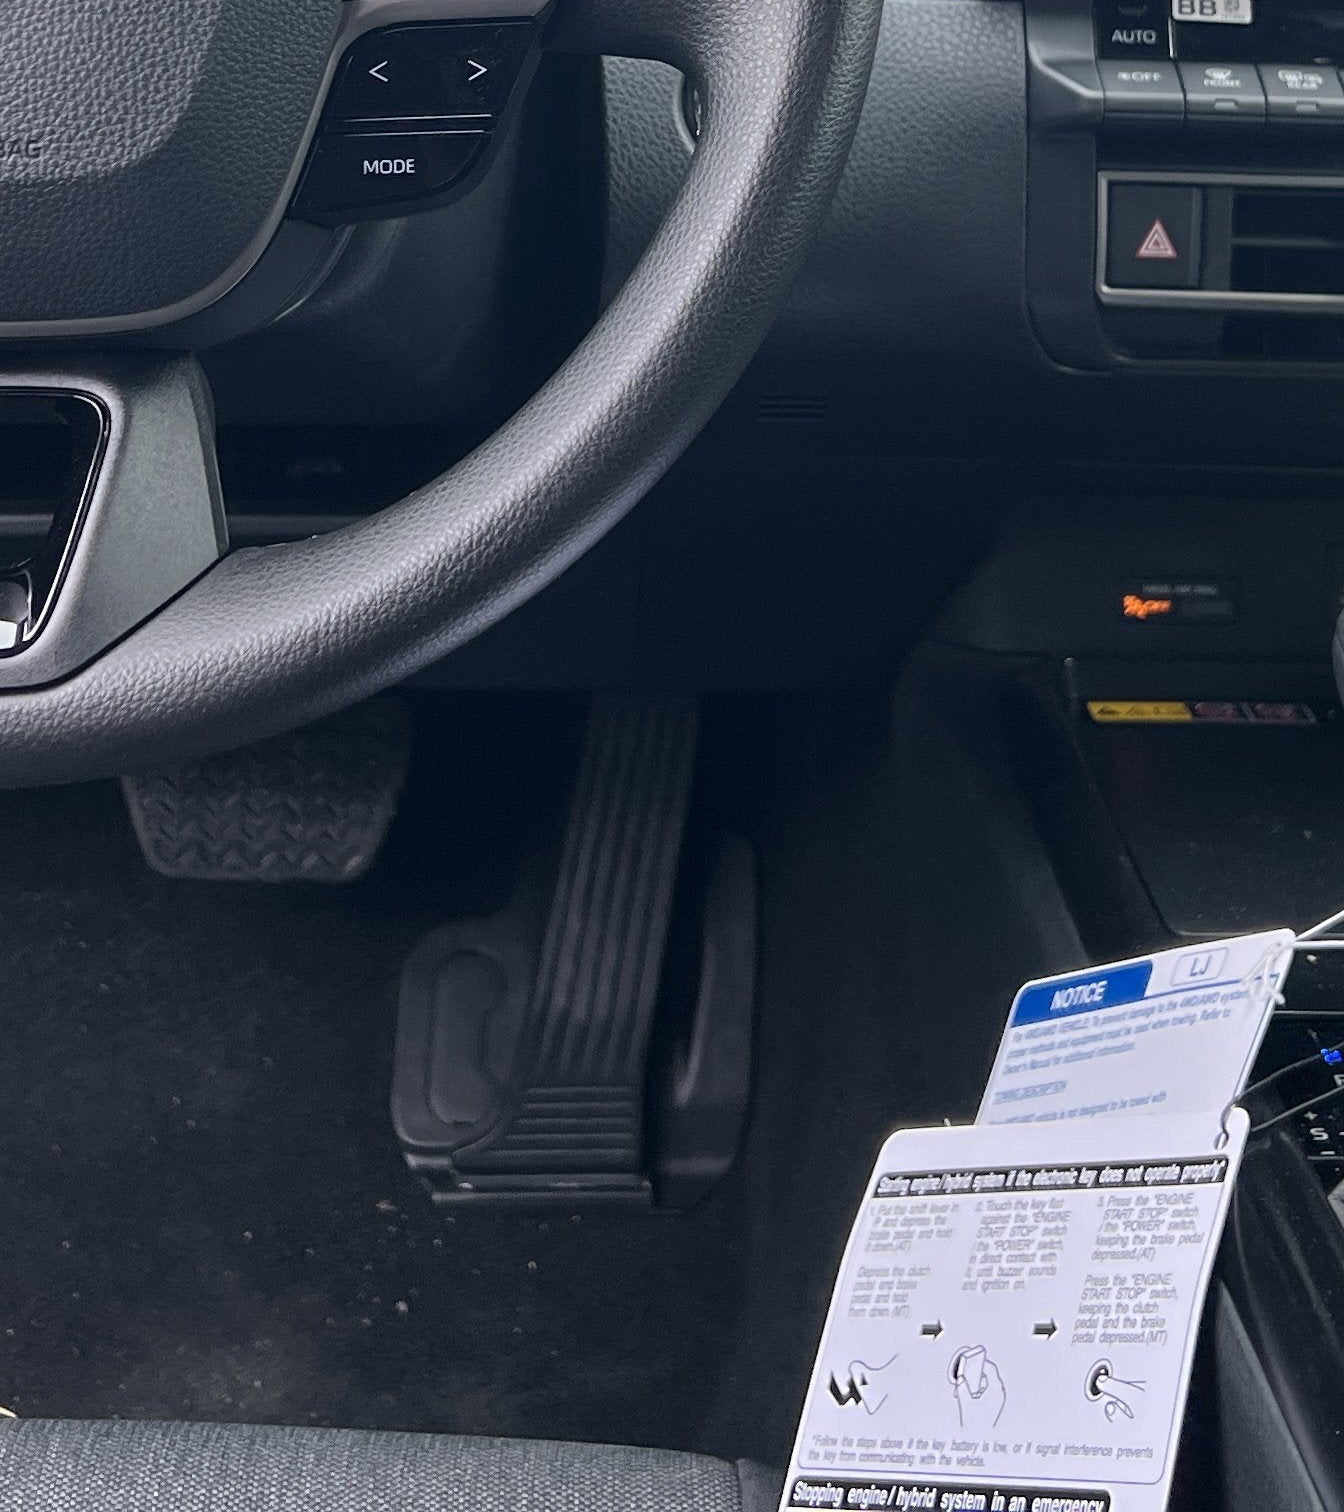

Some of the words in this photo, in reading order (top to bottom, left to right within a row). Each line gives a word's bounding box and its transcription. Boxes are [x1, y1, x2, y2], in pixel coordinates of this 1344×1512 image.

[1111, 29, 1157, 44] AUTO
[363, 159, 416, 175] MODE
[1050, 980, 1108, 1011] NOTICE
[1309, 1127, 1329, 1141] S
[792, 1480, 844, 1507] Stopping
[939, 1490, 987, 1512] system
[991, 1490, 1006, 1512] in
[1008, 1496, 1028, 1512] an
[1032, 1496, 1105, 1512] emergency
